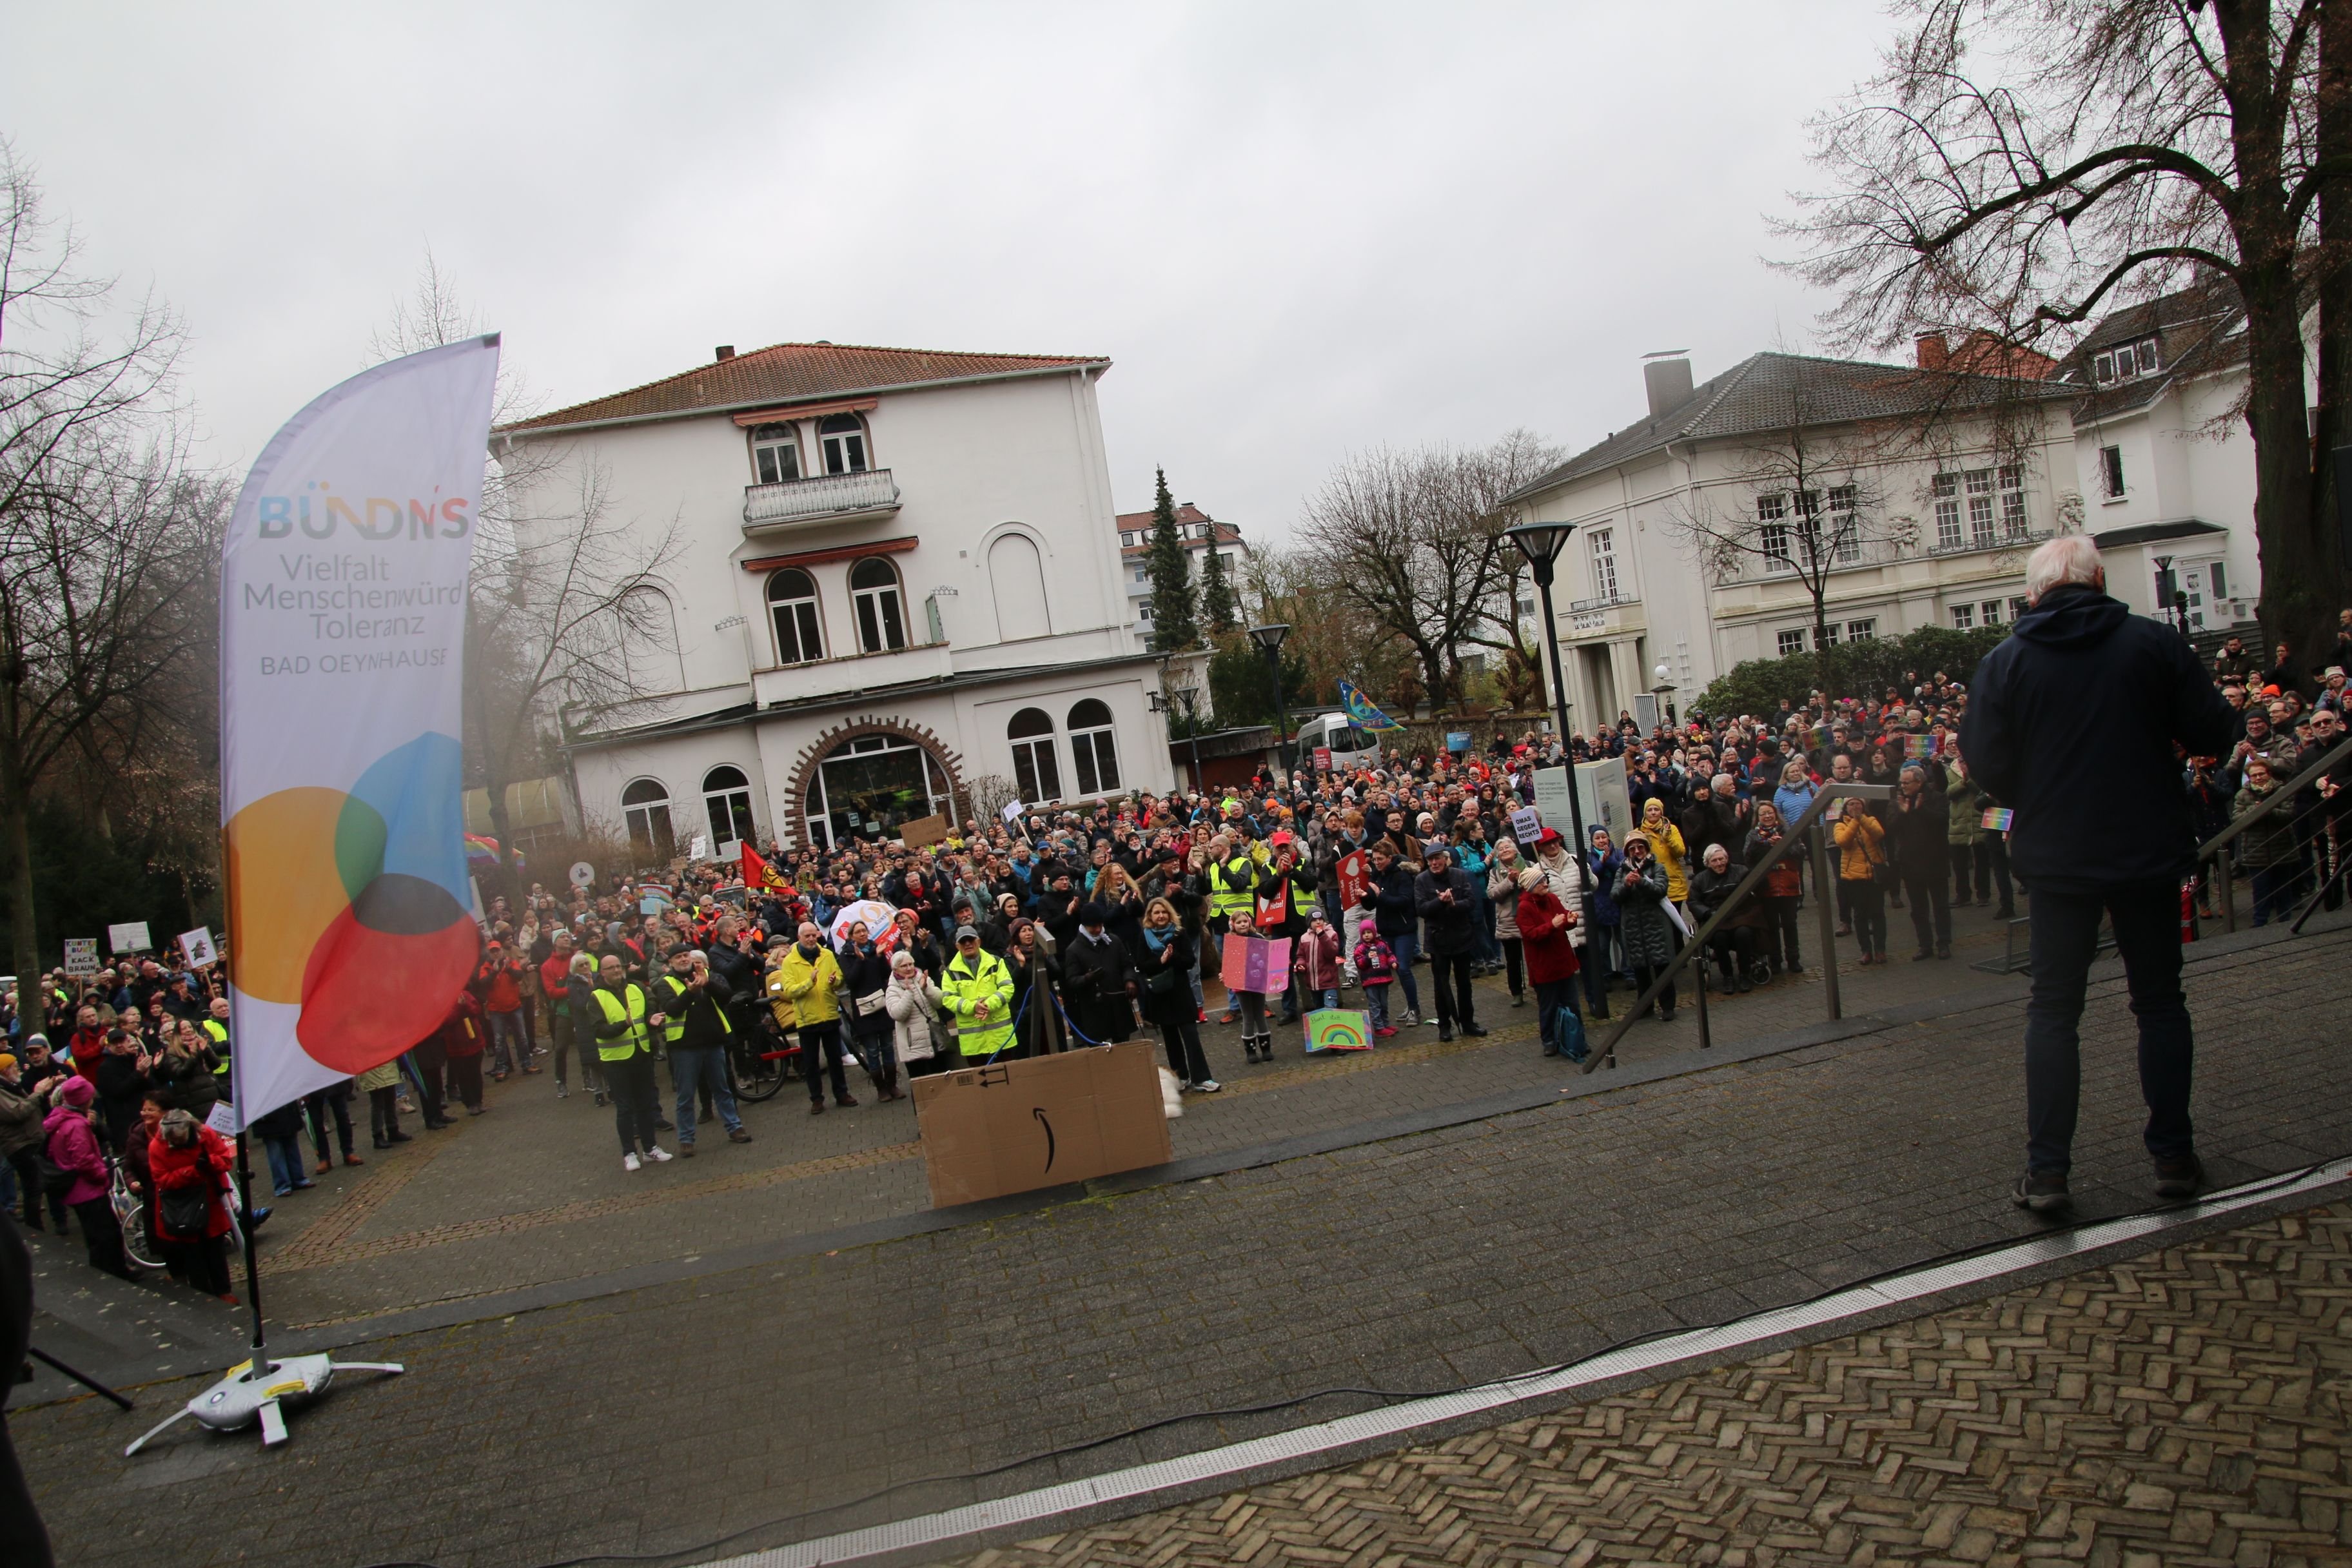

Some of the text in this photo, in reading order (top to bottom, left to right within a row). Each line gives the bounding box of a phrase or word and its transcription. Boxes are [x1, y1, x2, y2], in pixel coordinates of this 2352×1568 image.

[279, 554, 389, 581] Vielfalt
[309, 612, 426, 639] Toleranz
[260, 656, 310, 675] BAD
[1516, 816, 1531, 824] OMAS
[1517, 822, 1535, 831] GEGEN
[1518, 829, 1540, 839] RECHTS
[1311, 1014, 1325, 1024] Bunt
